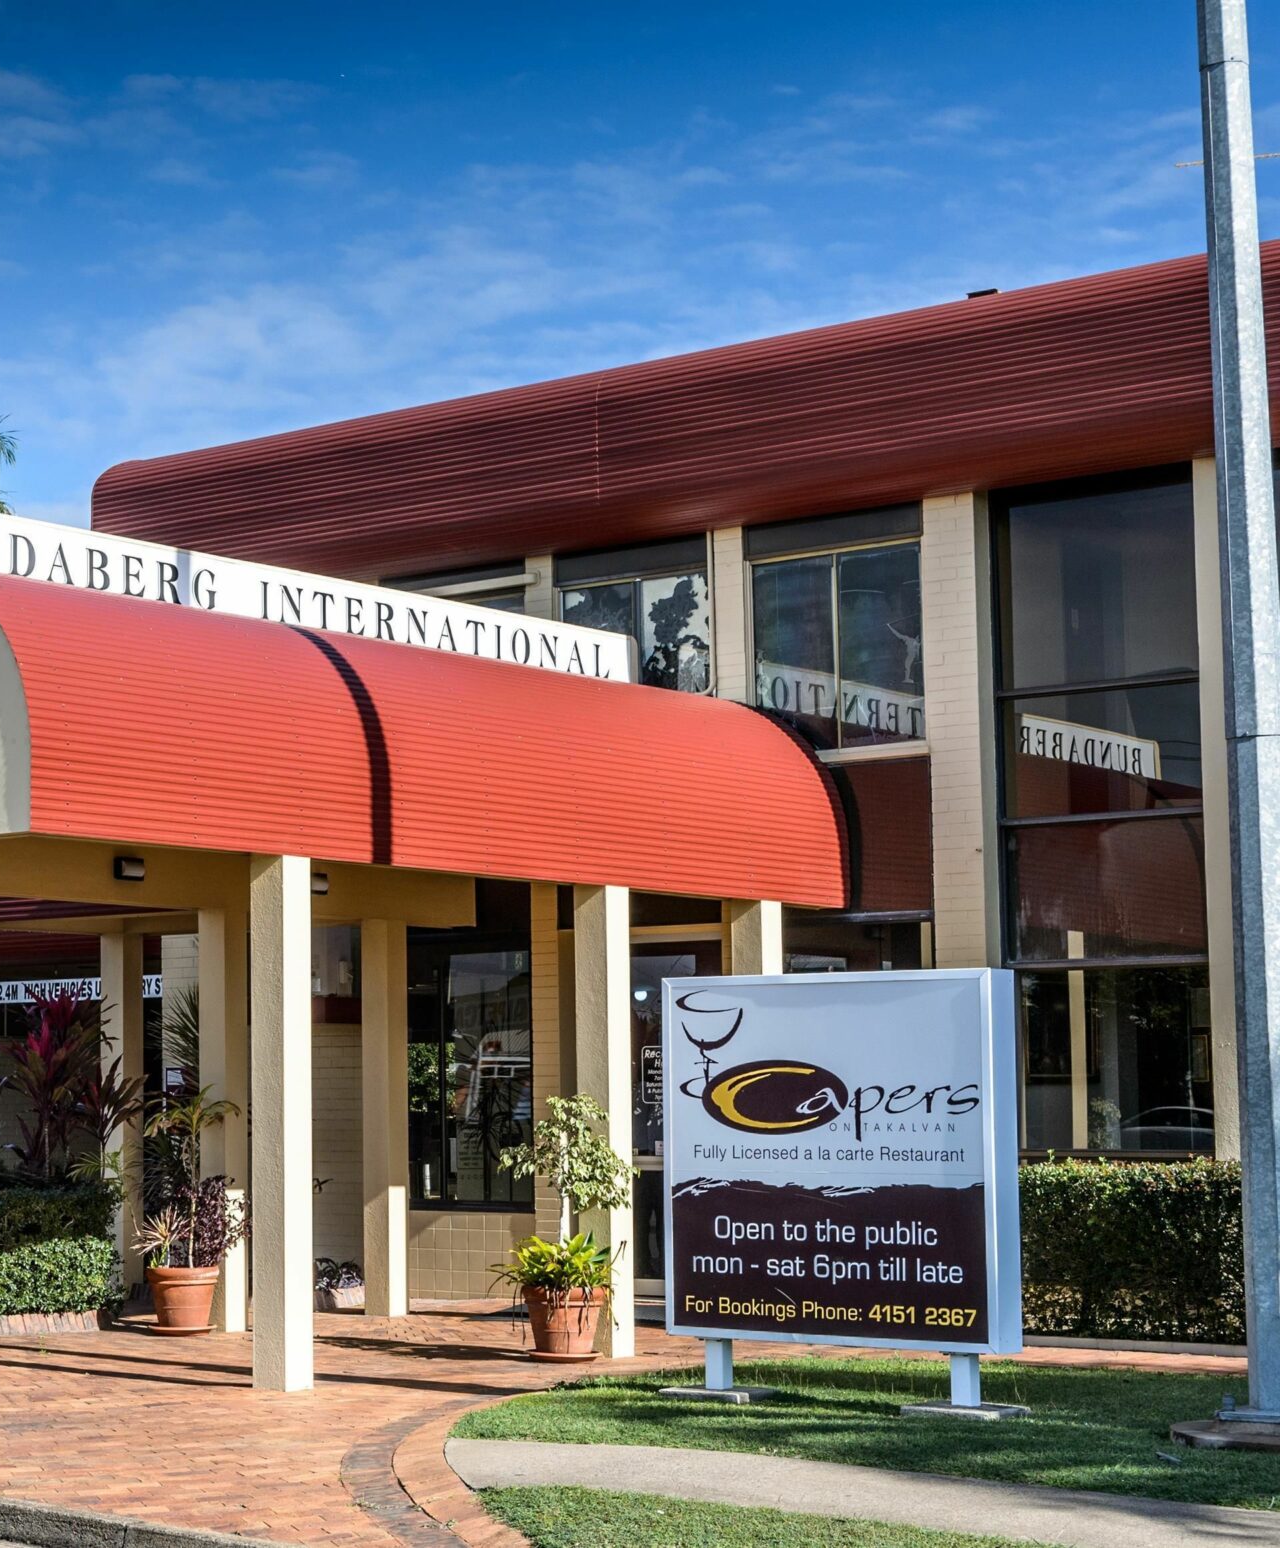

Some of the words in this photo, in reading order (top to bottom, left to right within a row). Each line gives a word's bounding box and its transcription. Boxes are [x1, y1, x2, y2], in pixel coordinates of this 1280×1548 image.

[260, 581, 611, 679] INTERNATIONAL
[24, 982, 46, 999] HIGH
[155, 977, 162, 993] S
[644, 1049, 662, 1059] Rec
[710, 1066, 980, 1142] Capers
[829, 1123, 851, 1132] ON
[863, 1123, 956, 1133] TAKALVAN
[694, 1144, 727, 1161] Fully
[732, 1144, 798, 1160] Licensed
[804, 1150, 813, 1160] a
[818, 1146, 831, 1161] la
[836, 1147, 874, 1161] carte
[880, 1146, 965, 1162] Restaurant
[714, 1215, 775, 1245] Open
[782, 1219, 807, 1242] to
[815, 1218, 856, 1242] the
[865, 1221, 938, 1250] public
[692, 1256, 744, 1274] mon
[766, 1256, 805, 1277] sat
[813, 1254, 870, 1284] 6pm
[878, 1256, 907, 1282] till
[916, 1258, 963, 1284] late
[685, 1295, 713, 1313] For
[718, 1296, 796, 1322] Bookings
[802, 1301, 863, 1322] Phone:
[868, 1304, 916, 1324] 4151
[925, 1307, 977, 1327] 2367
